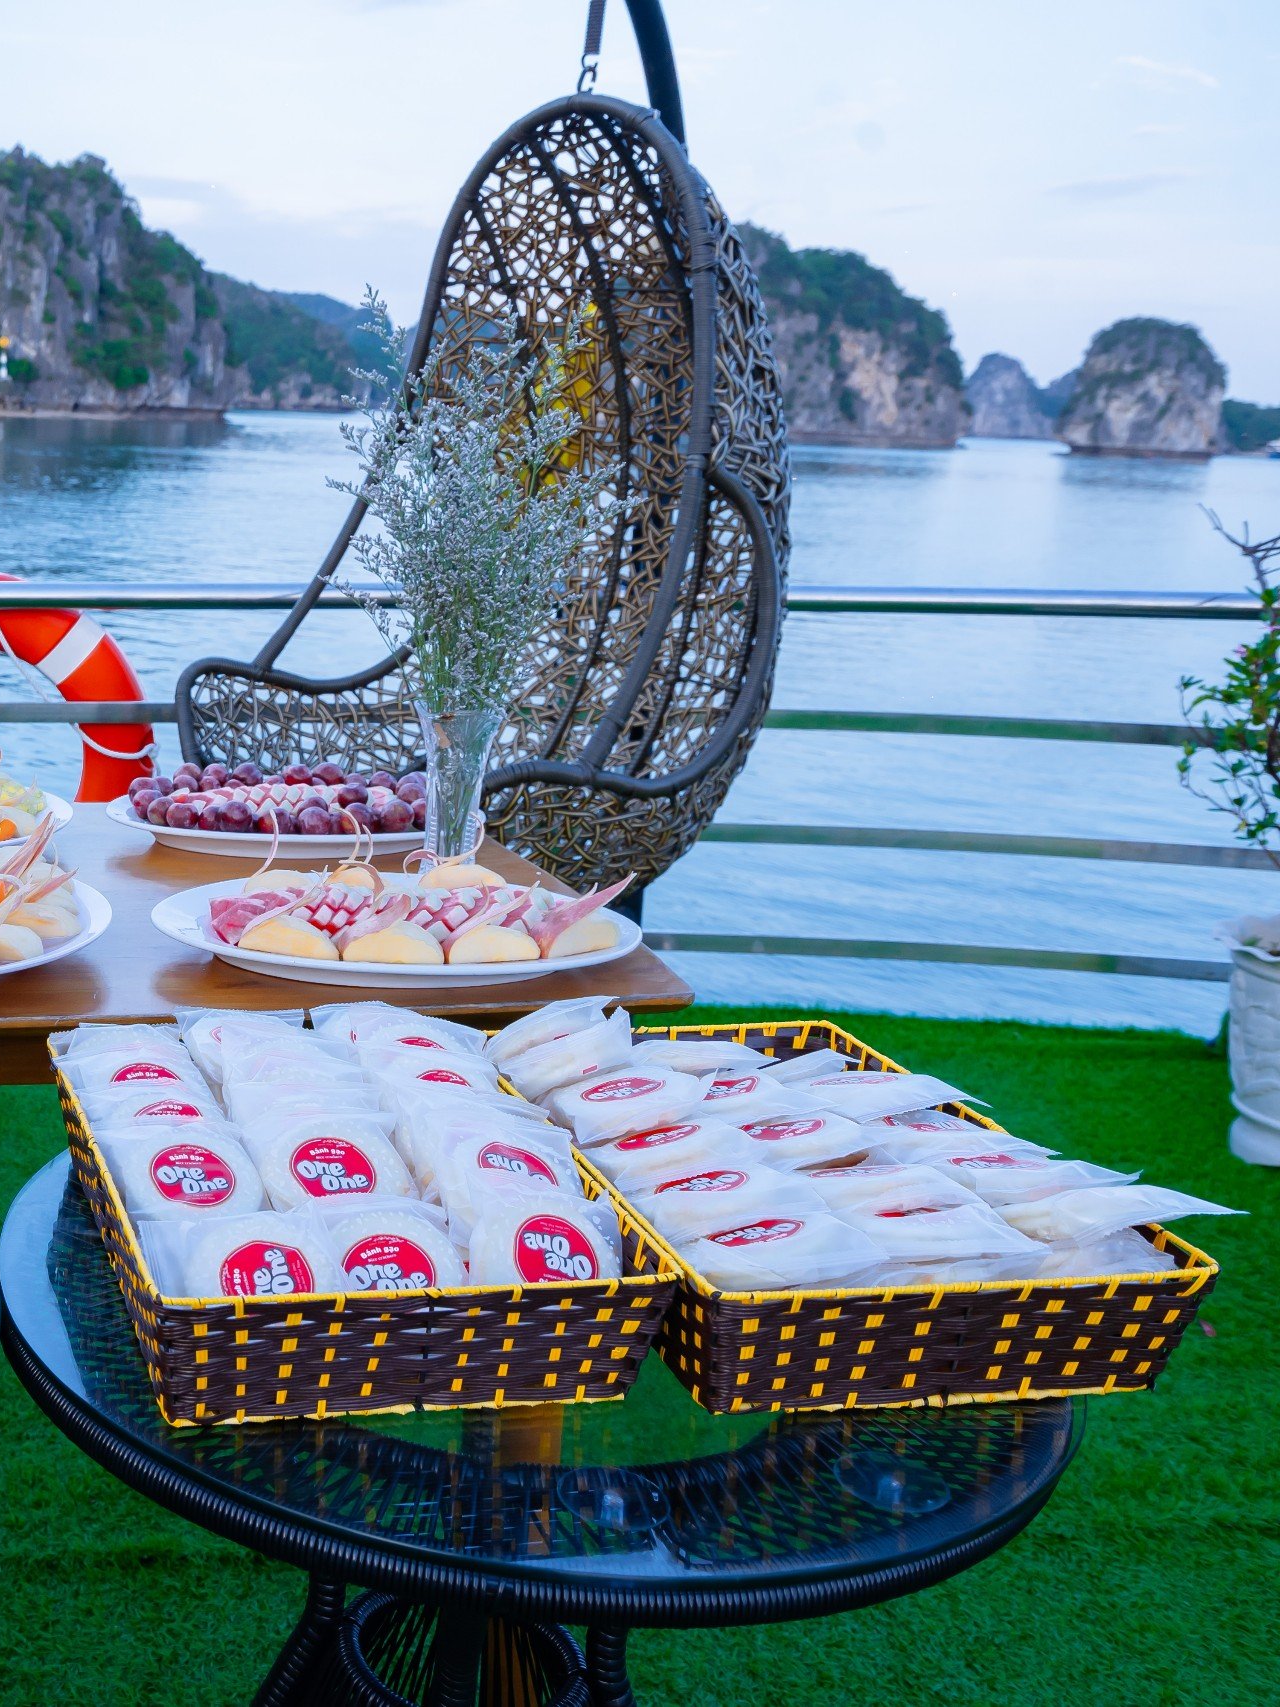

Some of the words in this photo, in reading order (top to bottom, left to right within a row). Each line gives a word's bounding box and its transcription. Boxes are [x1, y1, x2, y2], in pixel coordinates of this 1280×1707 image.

[309, 1147, 329, 1156] Bánh
[156, 1165, 205, 1184] One
[296, 1160, 346, 1179] One
[181, 1177, 229, 1194] One
[321, 1174, 369, 1191] One
[360, 1246, 382, 1259] Bánh
[523, 1232, 570, 1258] One
[264, 1249, 295, 1294] One
[544, 1252, 593, 1280] One
[253, 1267, 274, 1295] ne
[348, 1263, 401, 1290] One
